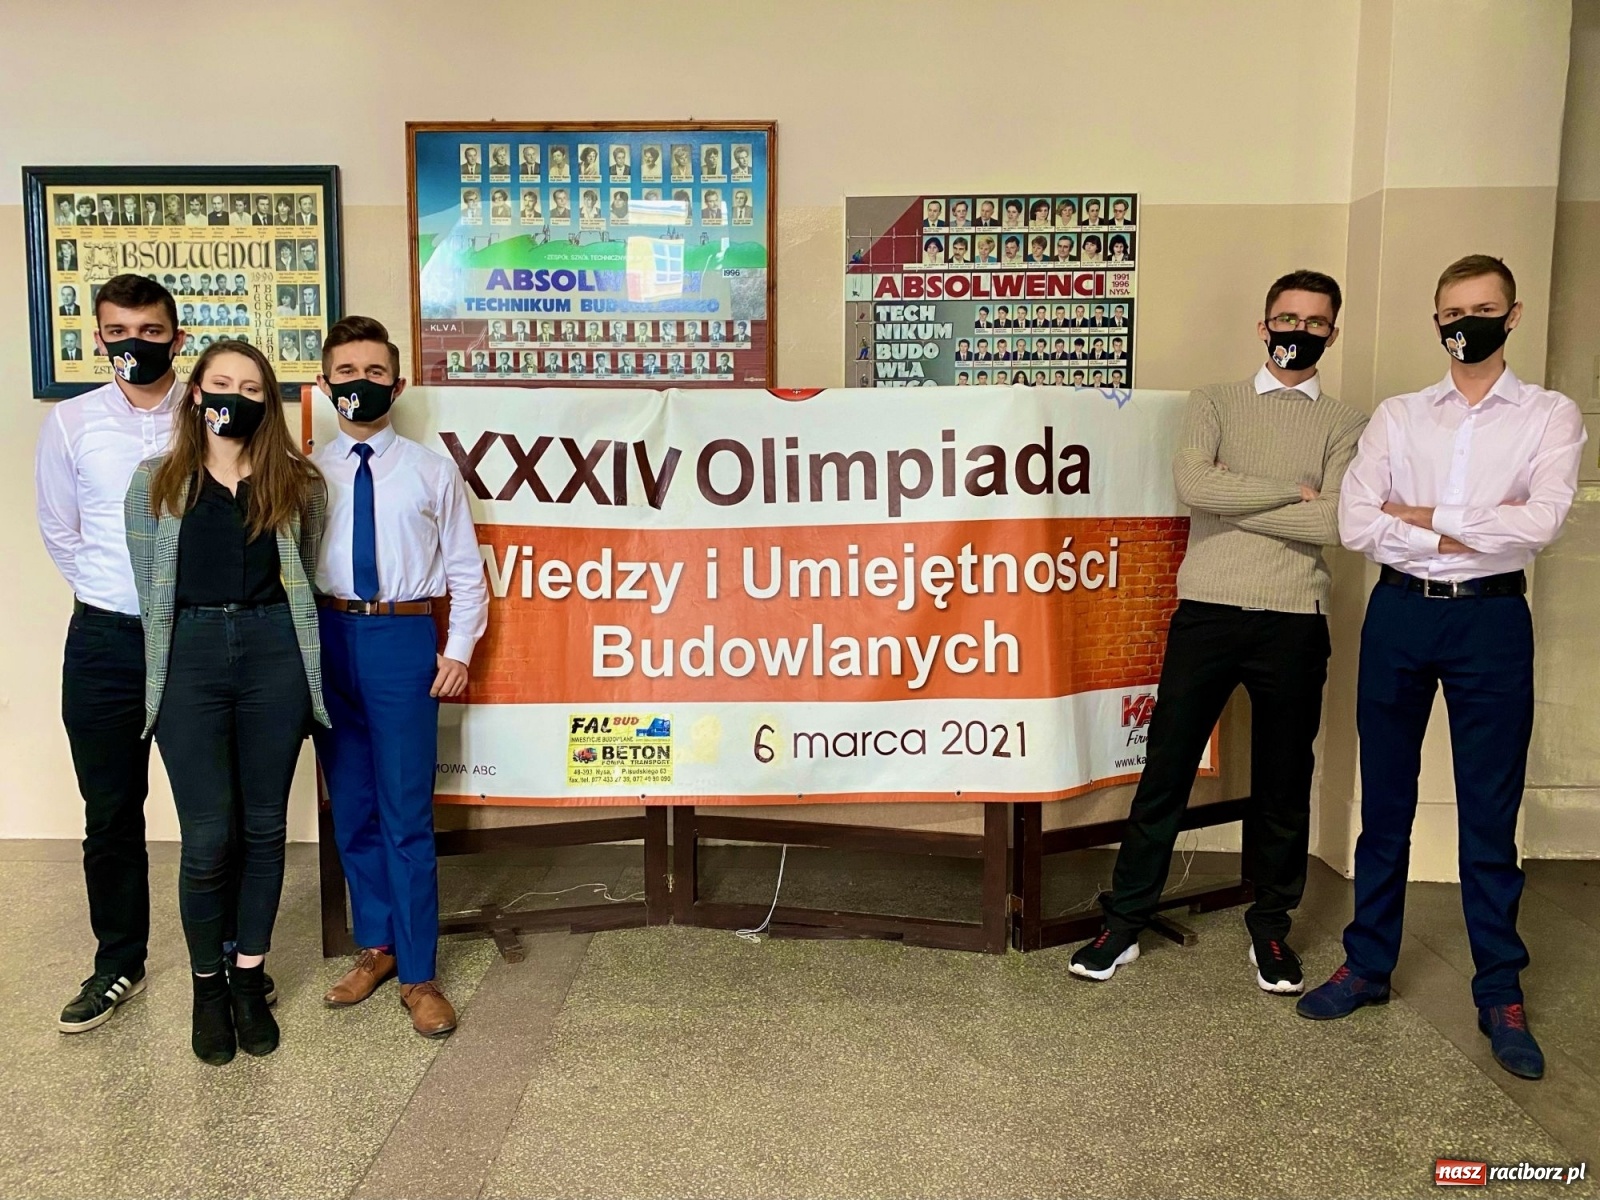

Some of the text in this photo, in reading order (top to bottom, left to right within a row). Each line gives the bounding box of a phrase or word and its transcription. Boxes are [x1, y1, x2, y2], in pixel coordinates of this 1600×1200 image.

[723, 269, 741, 277] 1996
[1112, 273, 1130, 281] 1991
[874, 274, 1104, 298] ABSOLWENCI
[1109, 288, 1131, 296] NYSA
[464, 298, 571, 313] TECHNIKUM
[876, 304, 936, 321] TECH
[876, 323, 953, 340] NIKUM
[875, 342, 940, 360] BUDO
[875, 361, 925, 378] WLA
[438, 426, 1091, 517] XXXIV Olimpiada
[706, 547, 718, 599] i
[743, 537, 1119, 612] Umiejętności
[592, 619, 1020, 690] Budowlanych
[571, 716, 639, 734] FAL BUD
[753, 720, 1027, 763] 6 marca 2021
[602, 746, 670, 760] BETON
[472, 765, 497, 776] ABC
